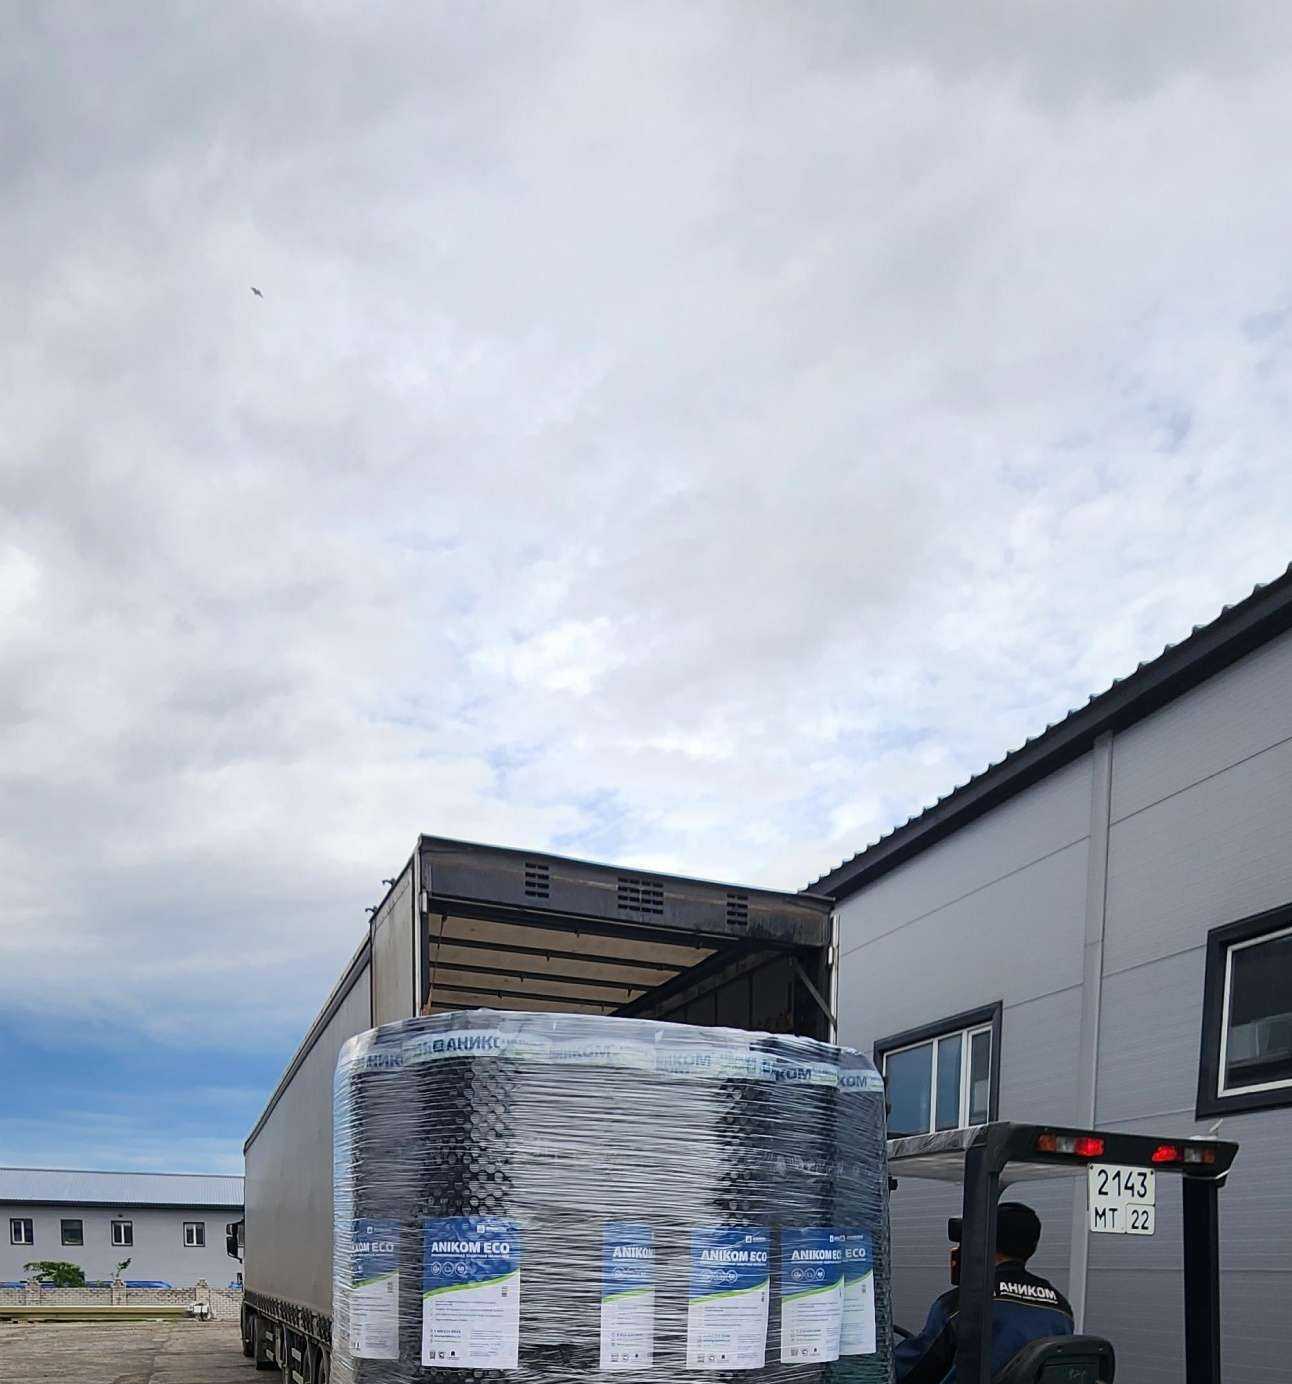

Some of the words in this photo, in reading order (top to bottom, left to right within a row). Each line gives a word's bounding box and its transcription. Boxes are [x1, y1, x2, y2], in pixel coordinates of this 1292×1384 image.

[1098, 1169, 1147, 1198] 2143
[1095, 1207, 1118, 1228] МТ
[1131, 1210, 1149, 1230] 22
[372, 1241, 395, 1252] ECO
[431, 1241, 481, 1253] ANIKOM
[483, 1241, 510, 1254] ECO
[845, 1248, 866, 1258] ECO
[701, 1249, 749, 1262] ANIKOM
[750, 1250, 767, 1262] ECO
[791, 1249, 832, 1260] ANIKOM
[1000, 1281, 1057, 1300] АНИКОМ
